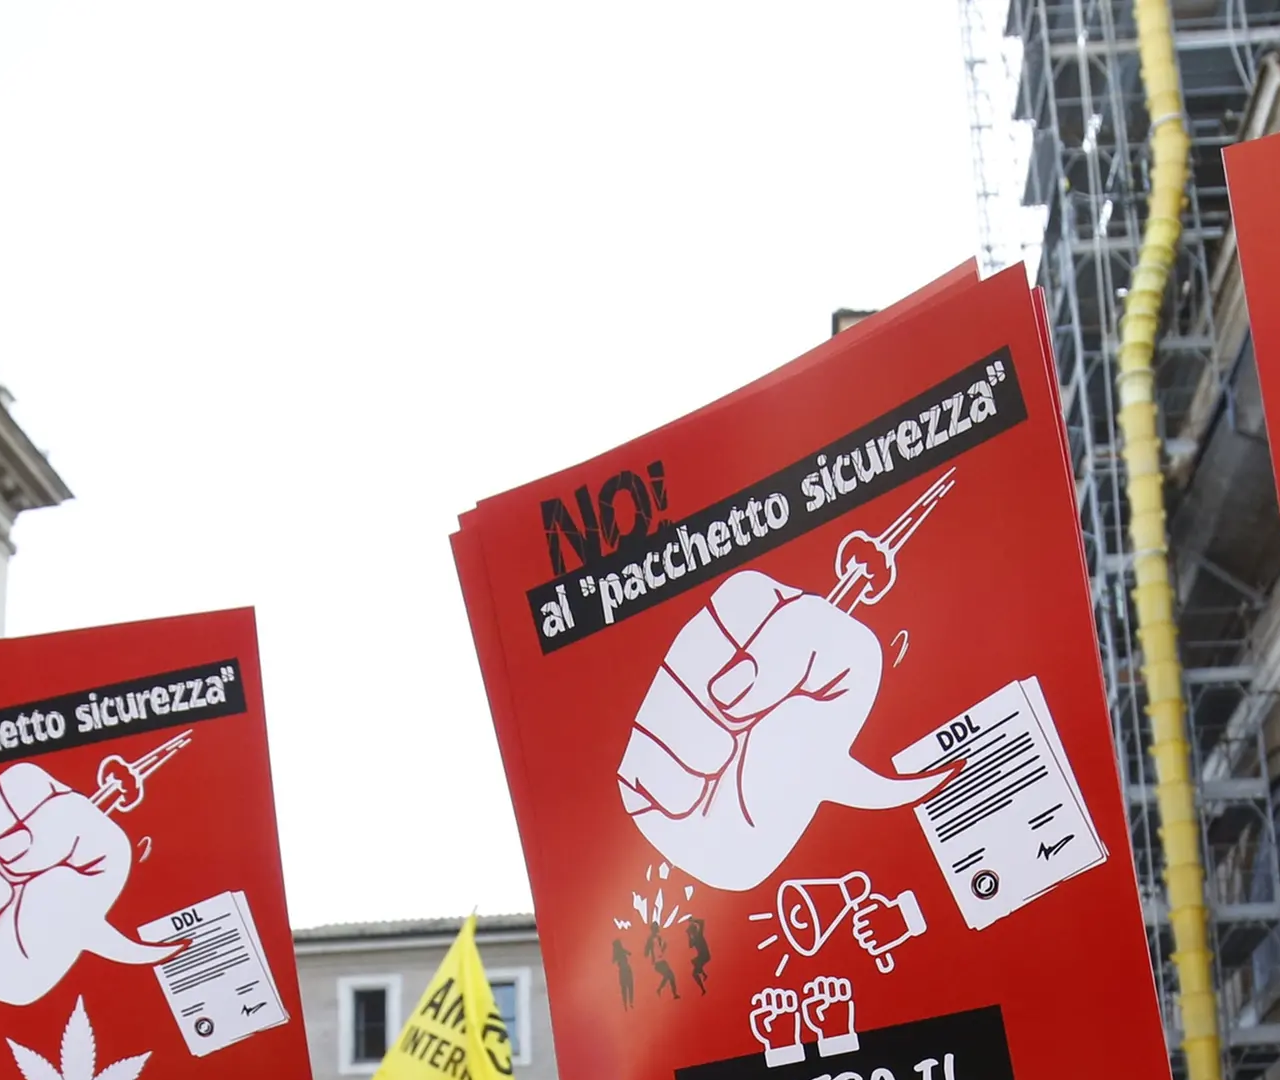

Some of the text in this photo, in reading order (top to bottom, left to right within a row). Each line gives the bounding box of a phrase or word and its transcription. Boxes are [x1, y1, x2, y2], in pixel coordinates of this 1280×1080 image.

[541, 460, 670, 572] NO!
[541, 590, 574, 637] al
[935, 714, 981, 751] DDL
[171, 909, 204, 931] DDL
